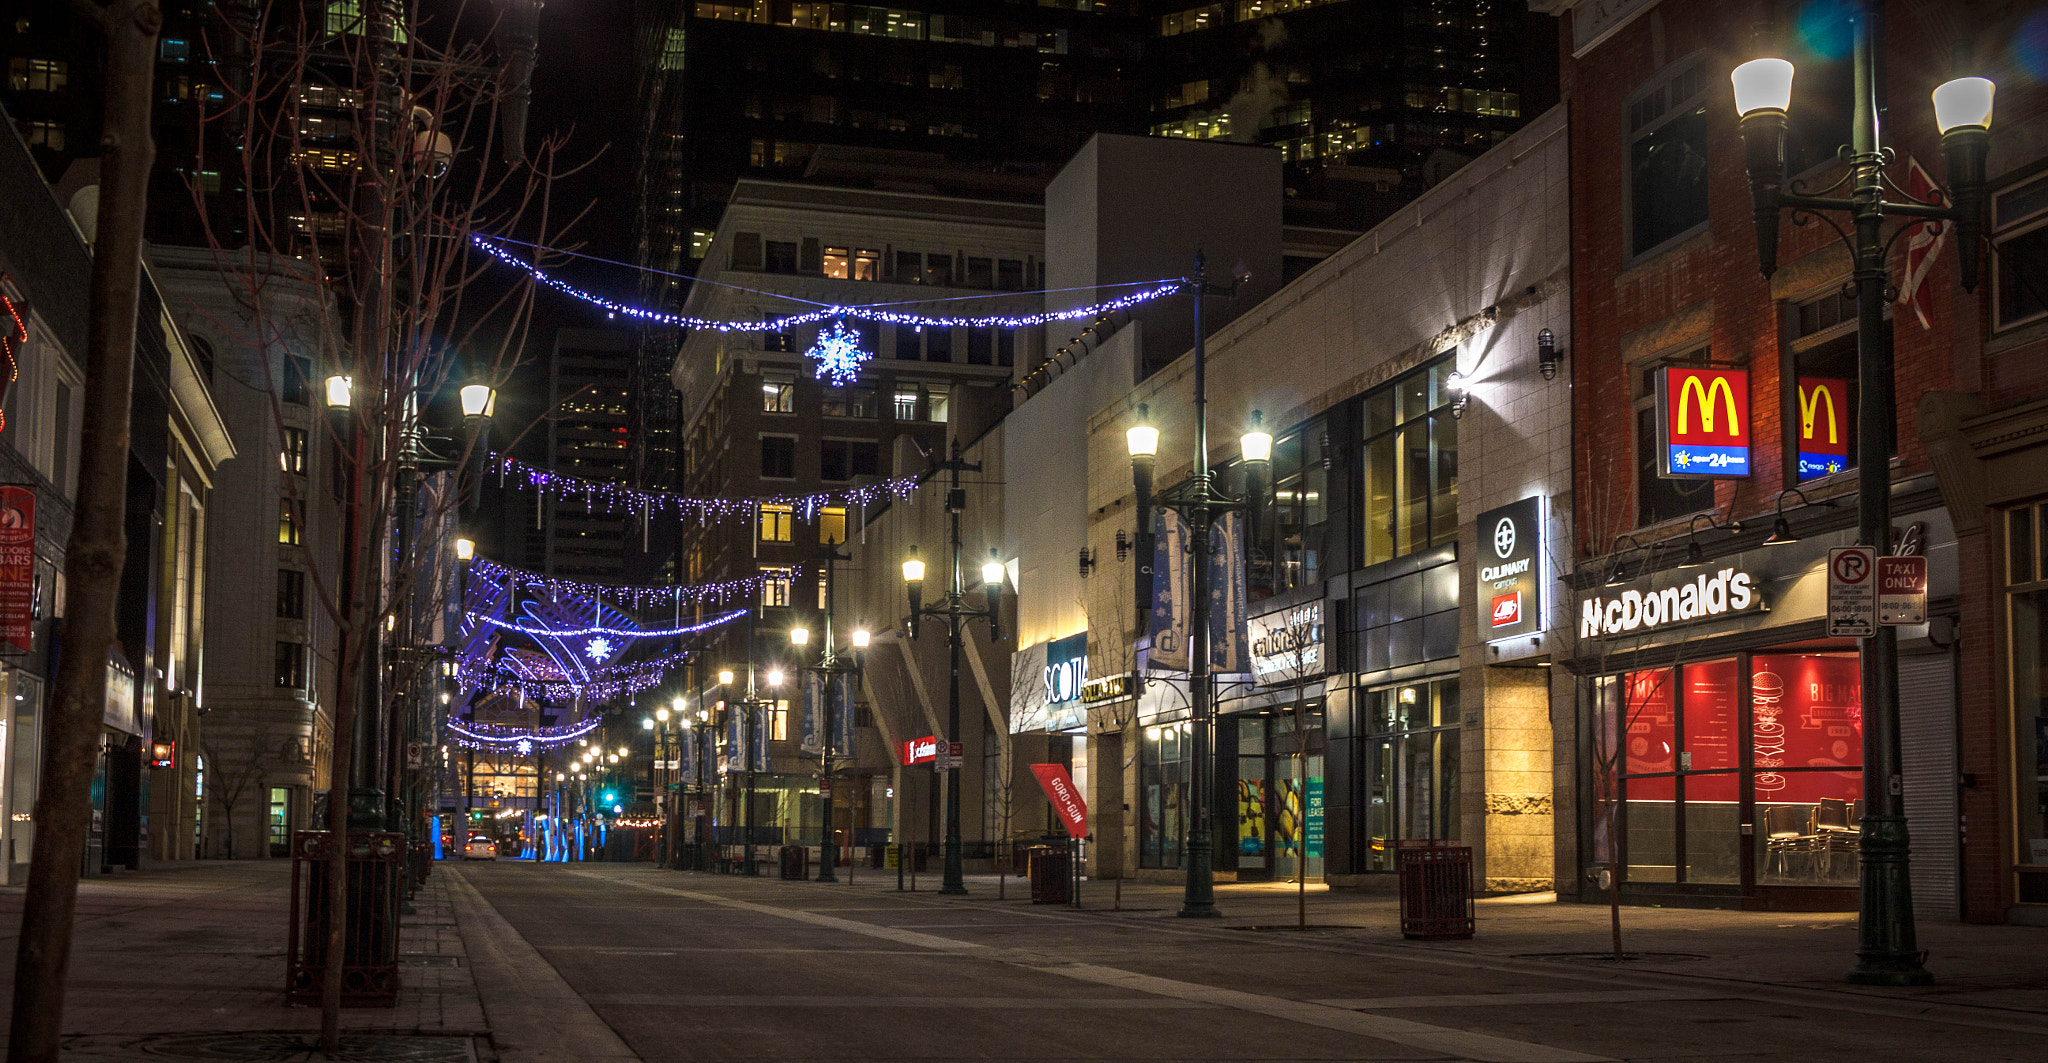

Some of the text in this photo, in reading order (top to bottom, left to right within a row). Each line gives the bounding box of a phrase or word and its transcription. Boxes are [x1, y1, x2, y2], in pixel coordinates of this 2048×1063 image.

[1709, 453, 1727, 467] 24
[1482, 559, 1529, 582] CULINARY
[1885, 563, 1916, 575] TAXI
[1494, 577, 1517, 590] campus
[1885, 577, 1918, 589] ONLY
[1580, 567, 1751, 639] McDonald's
[1810, 683, 1834, 702] BIG
[1310, 797, 1322, 807] FOR
[1308, 807, 1325, 818] LEASE
